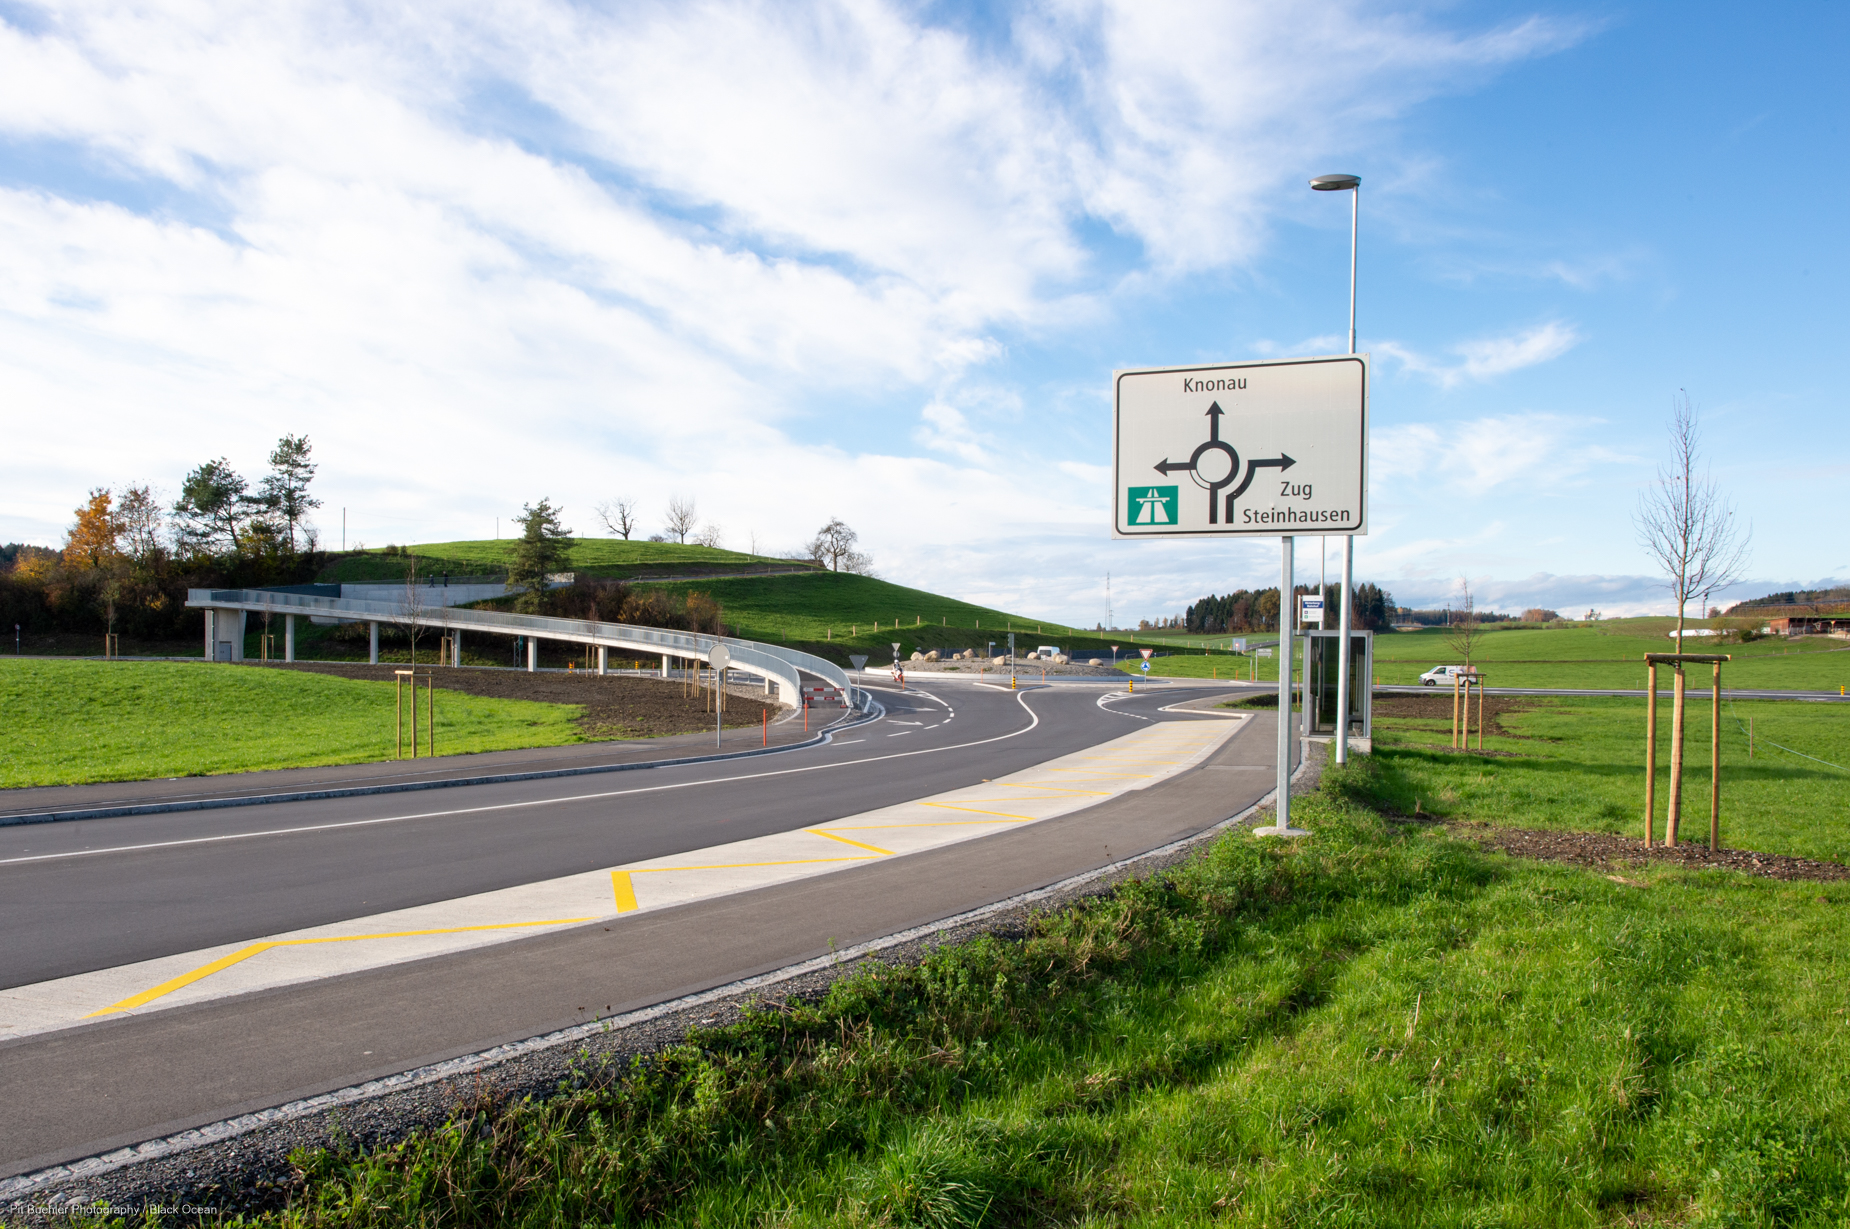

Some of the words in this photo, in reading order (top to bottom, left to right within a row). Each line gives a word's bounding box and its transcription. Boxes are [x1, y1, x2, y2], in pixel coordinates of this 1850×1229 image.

[1184, 377, 1247, 393] Knonau
[1280, 481, 1313, 500] Zug
[1243, 506, 1350, 524] Steinhausen
